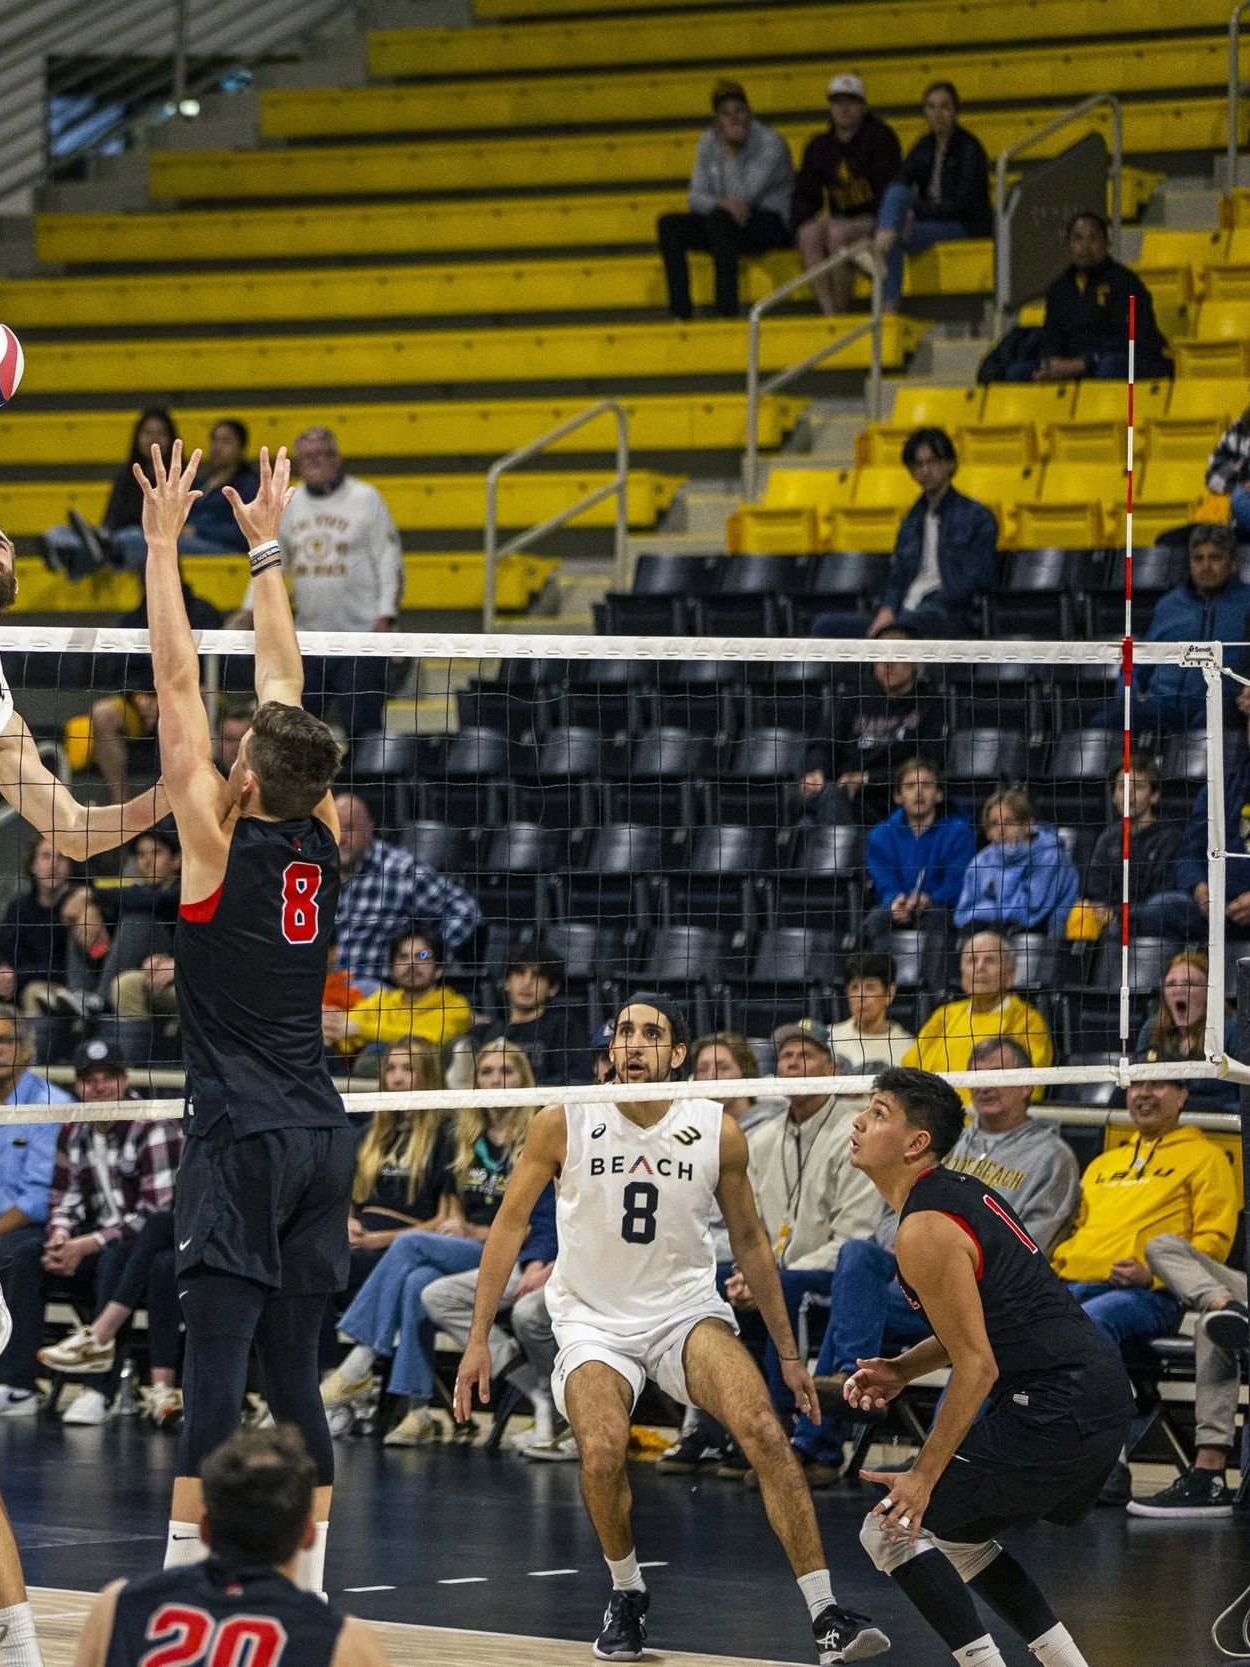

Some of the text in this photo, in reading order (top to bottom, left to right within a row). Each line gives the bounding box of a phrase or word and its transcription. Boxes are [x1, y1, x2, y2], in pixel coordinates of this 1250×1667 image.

[281, 861, 322, 944] 8
[590, 1155, 693, 1181] BEACH
[621, 1181, 659, 1245] 8
[983, 1194, 1038, 1255] 1
[136, 1601, 289, 1667] 20
